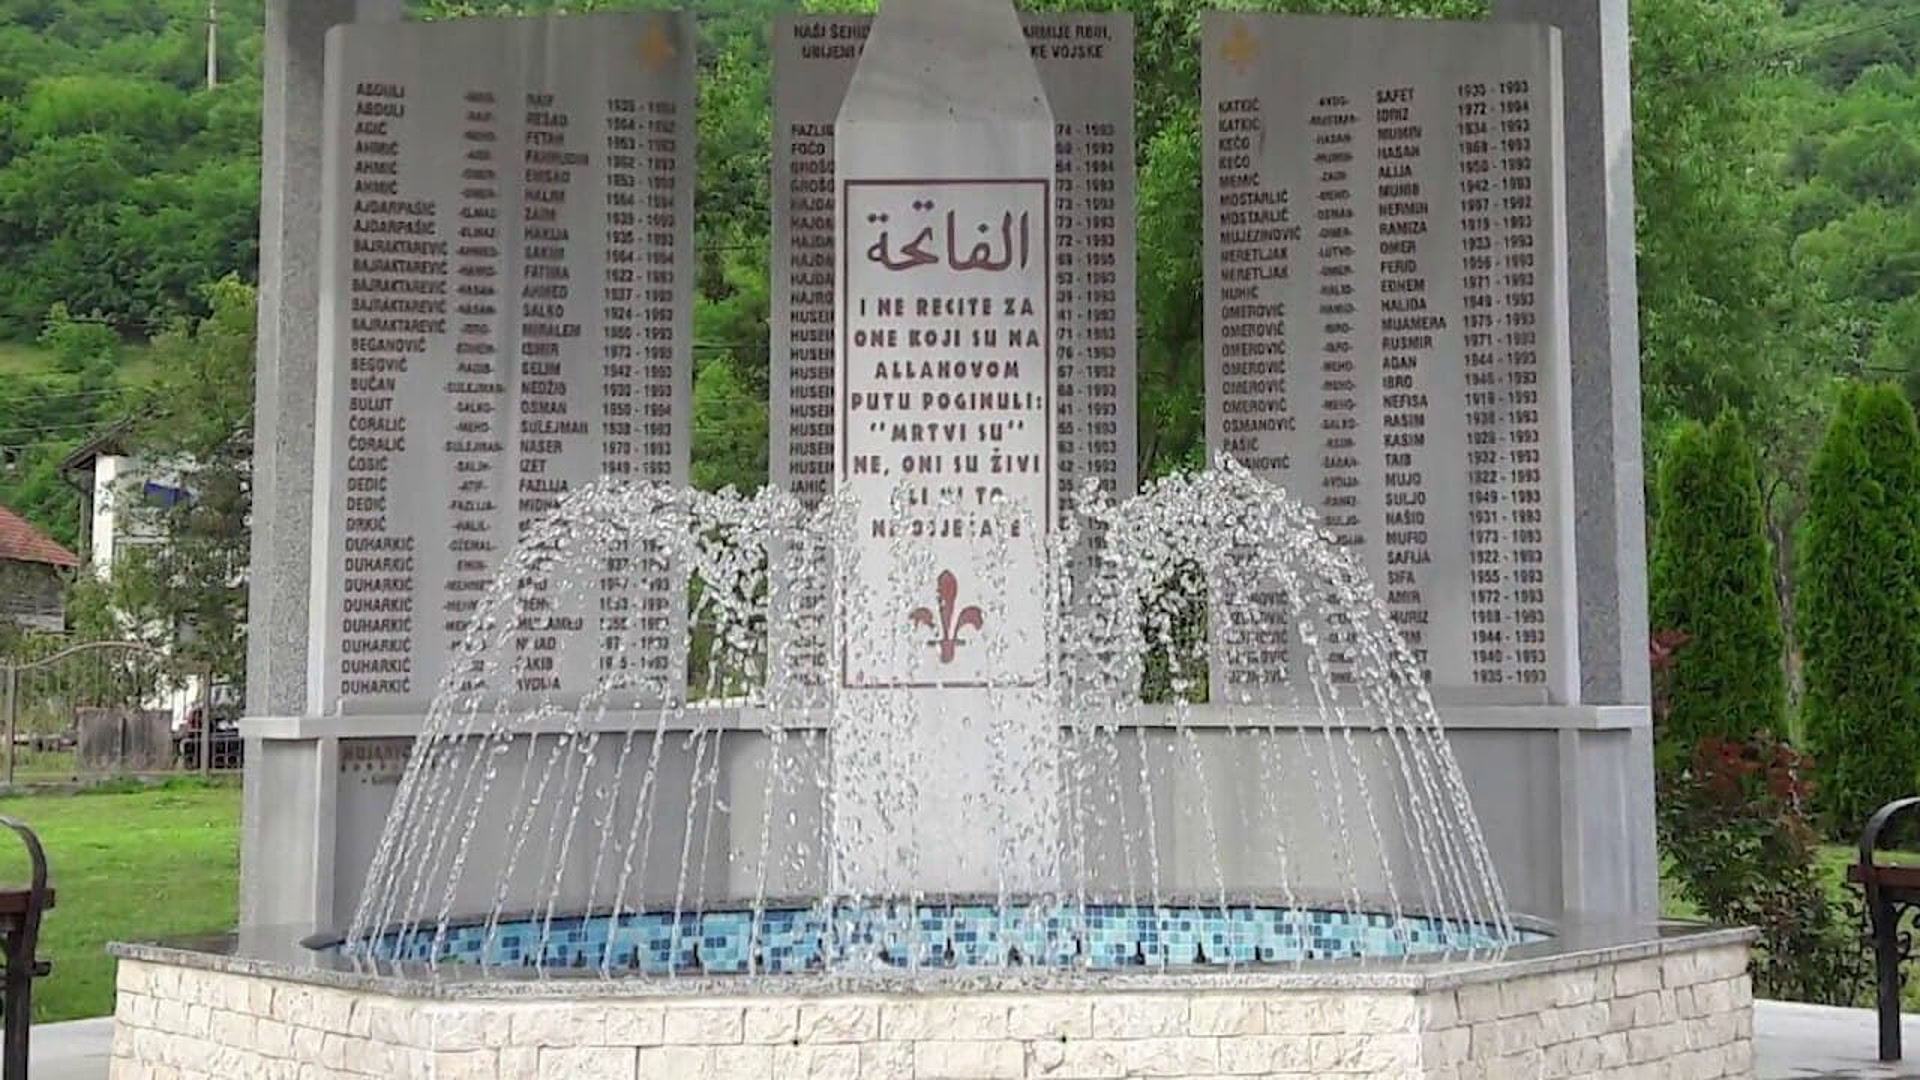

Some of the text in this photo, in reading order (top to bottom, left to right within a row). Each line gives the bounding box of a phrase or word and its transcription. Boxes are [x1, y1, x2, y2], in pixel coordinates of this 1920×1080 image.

[1052, 45, 1104, 58] VOJSKE
[867, 200, 1030, 271] الفاتحة
[1379, 221, 1427, 235] RAMIZA
[1379, 240, 1416, 254] OMER
[523, 304, 564, 318] SALKO
[860, 297, 1034, 317] I NE RECITE ZA
[1221, 304, 1285, 319] OMEROVIĆ
[1221, 323, 1285, 338] OMEROVIĆ
[351, 338, 426, 353] BEGANOVIĆ
[854, 329, 1040, 348] ONE KOJI SU NA
[1221, 342, 1286, 356] OMEROVIĆ
[350, 357, 561, 376] BEGOVIĆ SELIM
[875, 360, 1019, 380] ALLAHOVOM
[1221, 361, 1285, 376] OMEROVIĆ
[350, 377, 396, 391] BUČAN
[1222, 375, 1413, 395] OMEROVIĆ IBRO
[349, 397, 567, 415] BULUT OSMAN
[851, 392, 1046, 411] PUTU POGINULI:
[1222, 394, 1428, 414] OMEROVIĆ NEFISA
[520, 420, 589, 435] SULEJMAN
[1222, 414, 1425, 432] OSMANOVIĆ RASIM
[520, 439, 562, 454] NASER
[1384, 433, 1425, 447] KASIM
[853, 447, 1039, 476] NE, ONI SU ŽIVI
[1510, 448, 1539, 462] 1993
[519, 458, 546, 474] IZET
[1385, 472, 1422, 487] MUJO
[1510, 468, 1540, 482] 1993
[890, 487, 928, 505] LI
[1385, 492, 1426, 506] SULJO
[1511, 488, 1541, 502] 1993
[346, 496, 386, 512] DEDIĆ
[1512, 508, 1541, 522] 1993
[1386, 528, 1542, 545] MUFID 1973 1993
[344, 537, 414, 552] DUHARKIĆ
[1470, 549, 1500, 564] 1922
[344, 557, 414, 572] DUHARKIĆ
[1513, 568, 1543, 582] 1993
[344, 578, 413, 593] DUHARKIĆ
[1471, 589, 1500, 604] 1972
[1514, 588, 1543, 602] 1993
[343, 598, 412, 613] DUHARKIĆ
[342, 618, 411, 633] DUHARKIĆ
[1472, 630, 1502, 643] 1944
[341, 639, 411, 653] DUHARKIĆ
[341, 659, 411, 674] DUHARKIĆ
[1516, 668, 1546, 682] 1993
[341, 679, 410, 694] DUHARKIĆ
